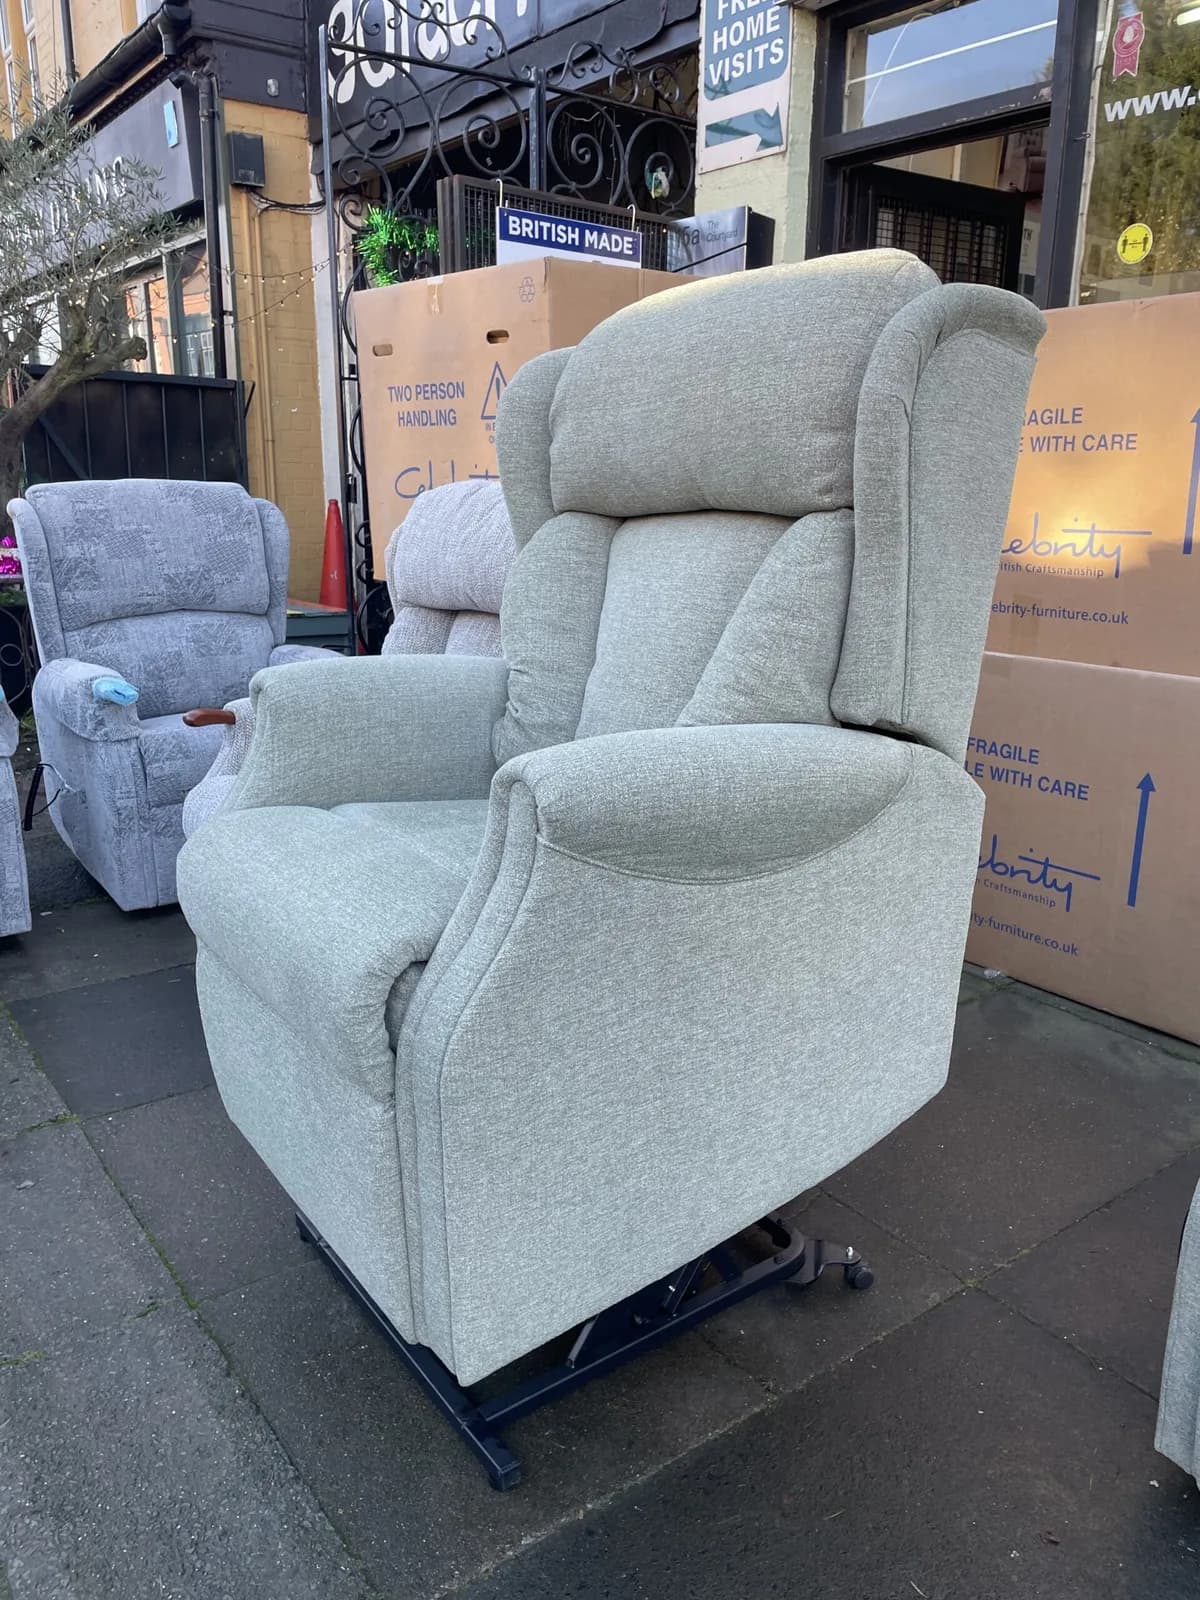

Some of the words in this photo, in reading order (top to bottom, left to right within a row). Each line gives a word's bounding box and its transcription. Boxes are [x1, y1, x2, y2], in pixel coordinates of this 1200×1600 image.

[717, 0, 786, 20] FR
[713, 6, 781, 55] HOME
[709, 38, 785, 86] VISITS
[1104, 85, 1200, 122] www.
[508, 215, 579, 246] BRITISH
[584, 229, 633, 255] MADE
[387, 385, 412, 403] TWO
[415, 381, 465, 401] PERSON
[397, 409, 457, 427] HANDLING
[1023, 407, 1083, 426] AGILE
[1030, 434, 1076, 453] WITH
[1081, 433, 1138, 452] CARE
[1025, 563, 1104, 579] Craftsmanship
[967, 736, 1040, 765] FRAGILE
[990, 765, 1032, 789] WITH
[1038, 776, 1090, 801] CARE
[984, 878, 1056, 908] Craftsmanship
